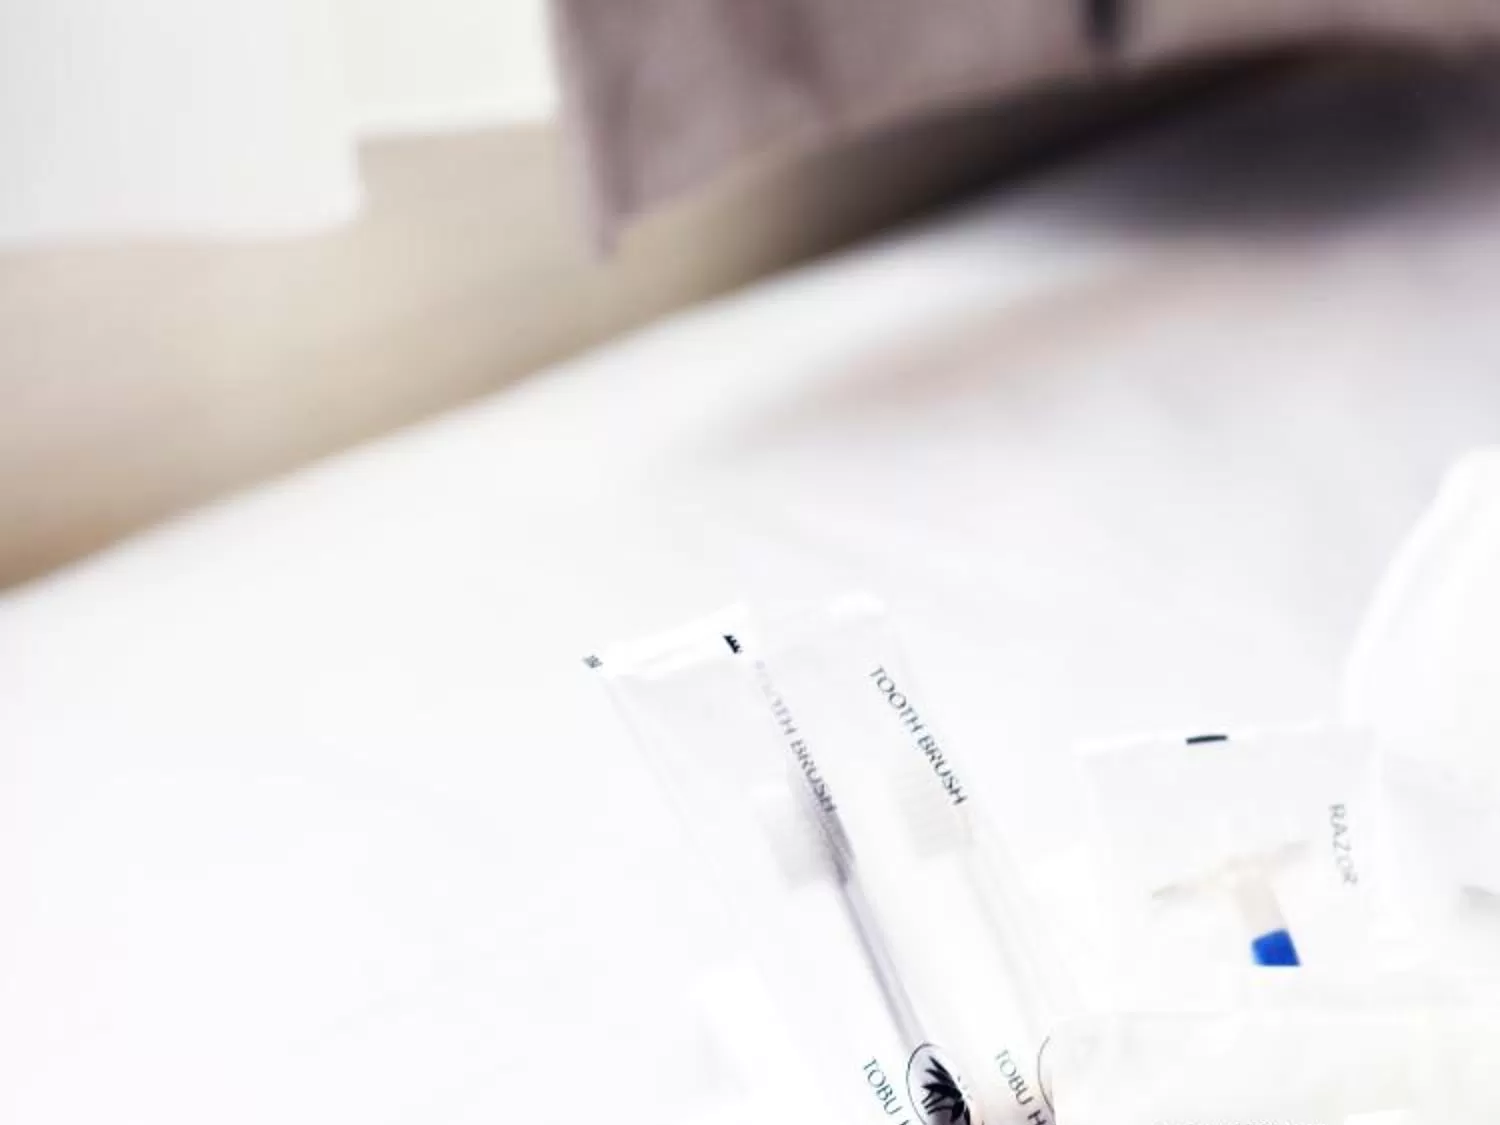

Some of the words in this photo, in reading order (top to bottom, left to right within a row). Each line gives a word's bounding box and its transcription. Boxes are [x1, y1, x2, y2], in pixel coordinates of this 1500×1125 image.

[869, 664, 924, 733] TOOTH
[917, 734, 968, 806] BRUSH
[790, 739, 838, 814] BRUSH
[862, 1058, 904, 1116] TOBU
[995, 1049, 1035, 1107] TOBU
